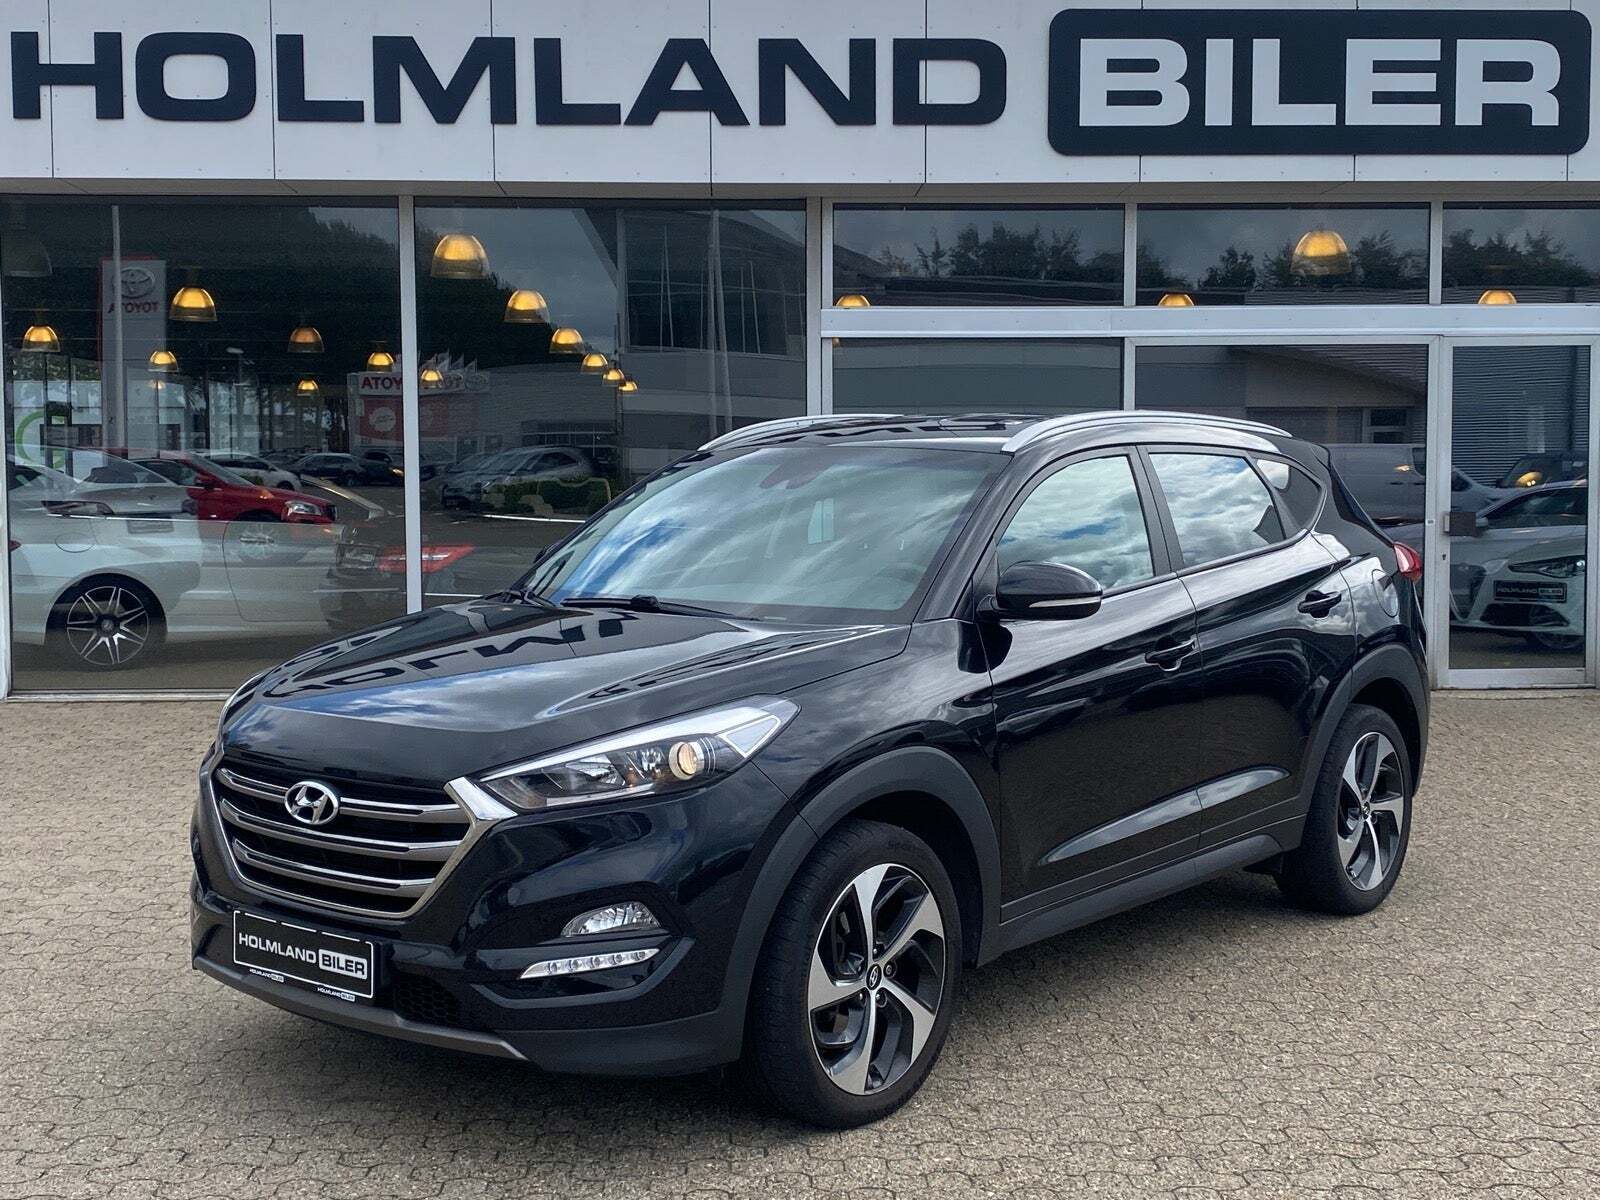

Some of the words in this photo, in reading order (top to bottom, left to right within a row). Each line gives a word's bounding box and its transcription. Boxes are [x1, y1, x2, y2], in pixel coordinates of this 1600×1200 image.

[11, 32, 1006, 127] HOLMLAND
[1080, 38, 1560, 127] BILER
[238, 932, 317, 964] HOLMLAND
[321, 953, 366, 976] BILER
